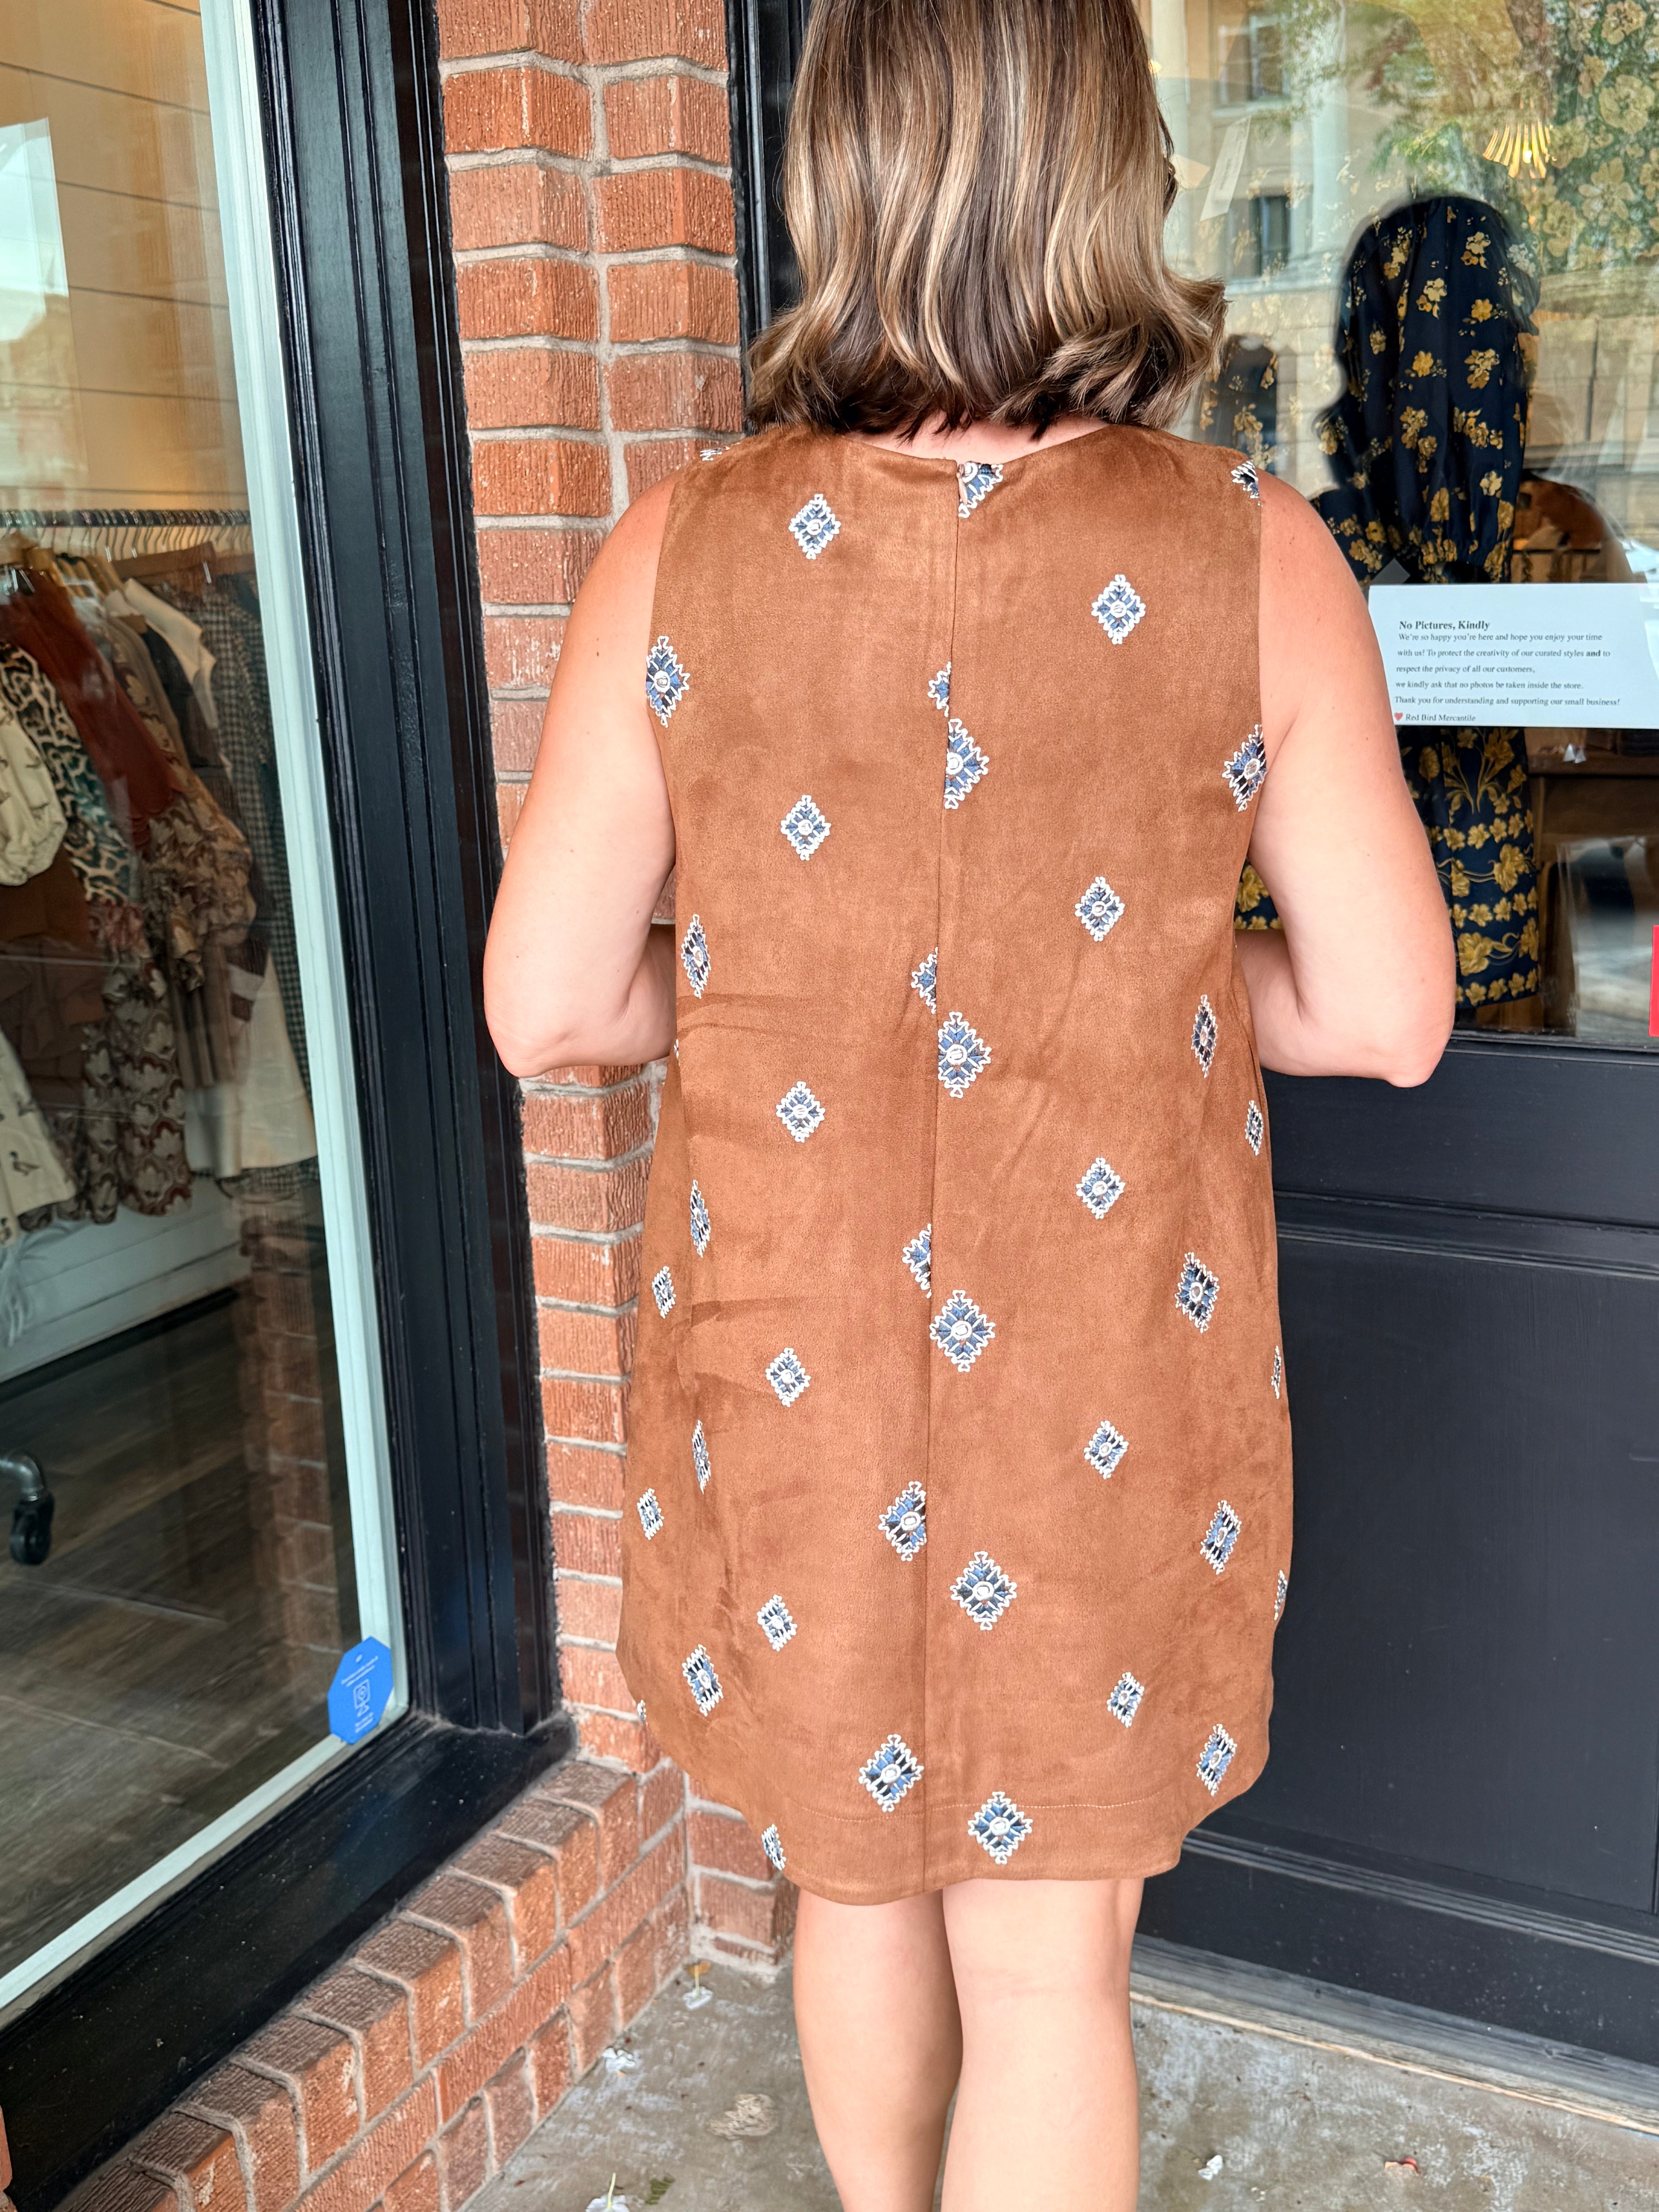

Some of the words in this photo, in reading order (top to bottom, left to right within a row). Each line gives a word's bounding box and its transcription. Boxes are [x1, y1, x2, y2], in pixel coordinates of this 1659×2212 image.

[1400, 621, 1412, 629] No
[1415, 621, 1455, 630] Pictures,
[1458, 620, 1490, 631] Kindly
[1431, 634, 1451, 642] happy
[1453, 634, 1476, 642] you're
[1510, 634, 1527, 642] hope
[1564, 650, 1584, 658] styles
[1407, 681, 1429, 689] kindly
[1445, 697, 1494, 706] understanding
[1511, 698, 1548, 706] supporting
